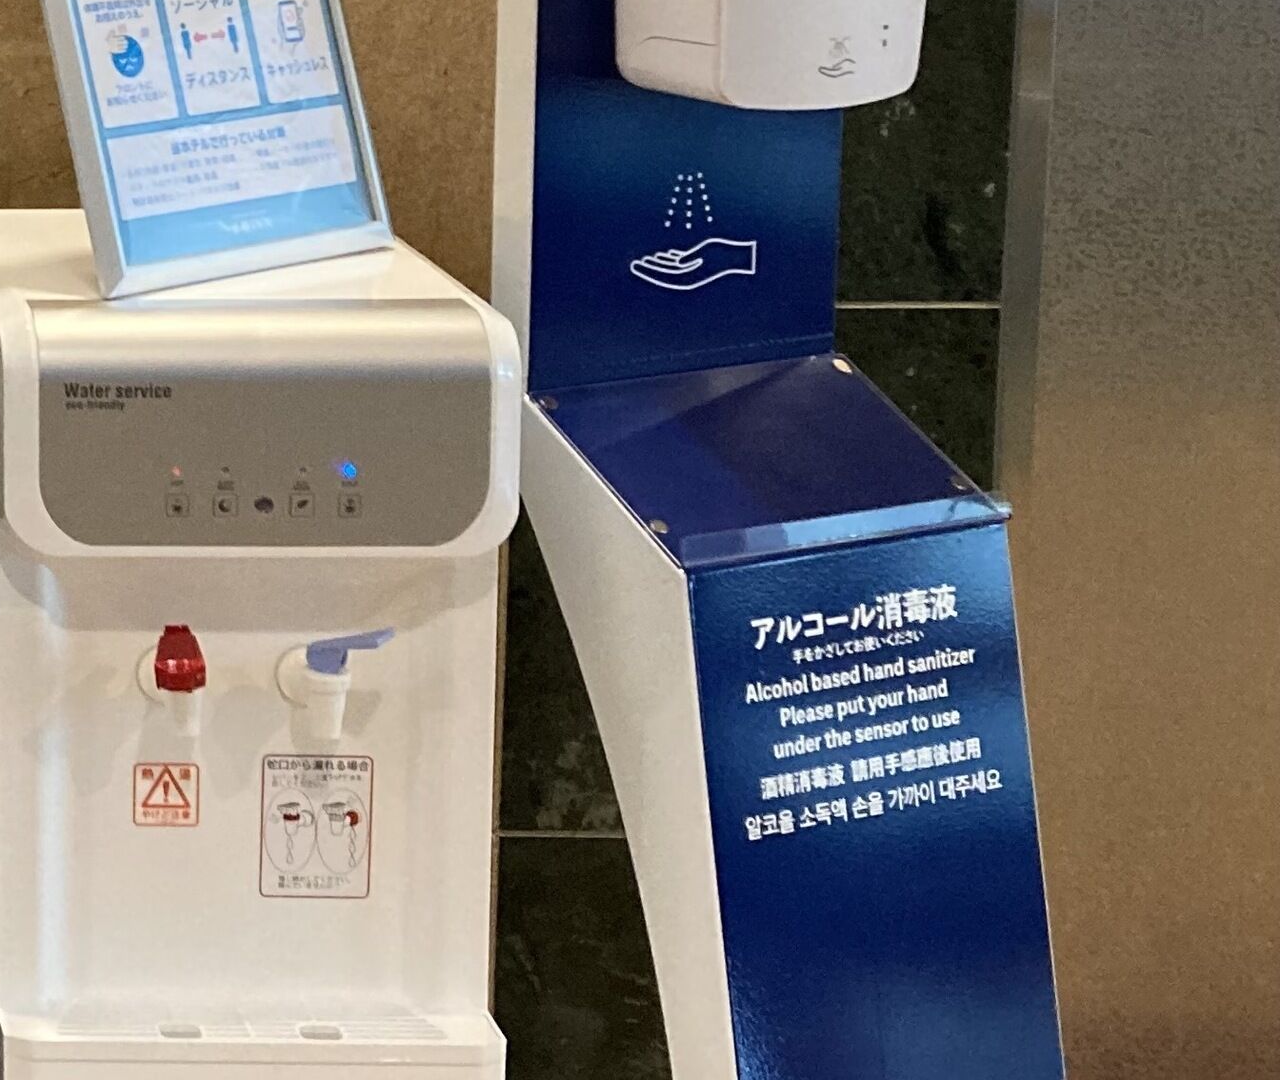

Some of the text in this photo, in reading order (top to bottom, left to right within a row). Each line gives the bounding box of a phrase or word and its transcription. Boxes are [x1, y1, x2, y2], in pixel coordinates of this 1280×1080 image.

[186, 67, 251, 89] ディスタンス
[266, 56, 329, 77] キャッシュレス
[64, 382, 173, 398] Water service
[750, 583, 958, 650] アルコール消毒液
[745, 647, 976, 704] Alcohol based hand sanitizer
[780, 678, 949, 728] Please put your hand
[774, 708, 961, 760] under the sensor to use
[745, 769, 1003, 841] 알코올 소독액 손을 가까이 대주세요
